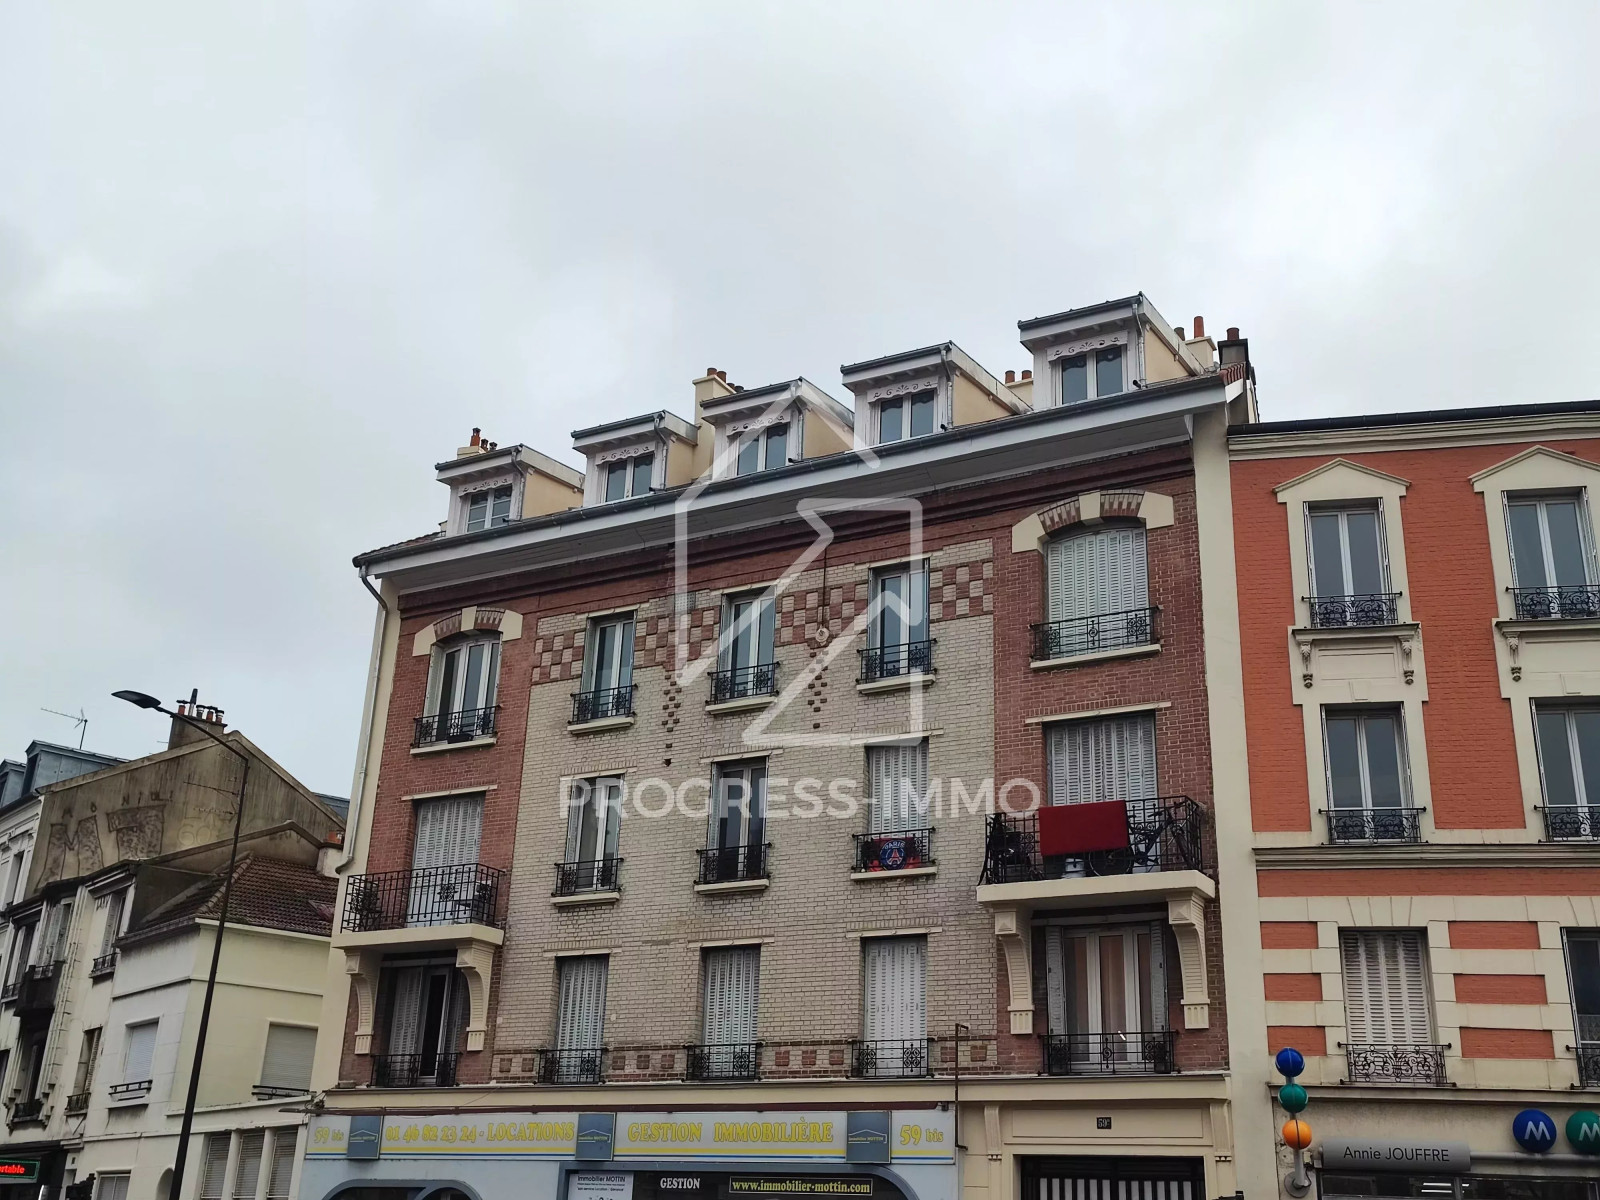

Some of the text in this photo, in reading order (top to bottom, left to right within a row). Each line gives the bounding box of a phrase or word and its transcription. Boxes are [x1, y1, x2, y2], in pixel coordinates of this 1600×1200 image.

[314, 1127, 330, 1143] 59
[385, 1125, 400, 1141] 01
[440, 1125, 457, 1143] 23
[459, 1125, 476, 1143] 24
[487, 1122, 575, 1142] LOCATIONS
[627, 1117, 834, 1143] GESTION IMMOBILIÈRE
[900, 1125, 944, 1145] 59 bis
[1524, 1120, 1551, 1140] M
[1343, 1146, 1450, 1162] Annie JOUFFRE
[660, 1177, 701, 1189] GESTION
[732, 1179, 871, 1193] www.immobilier-mottin.com
